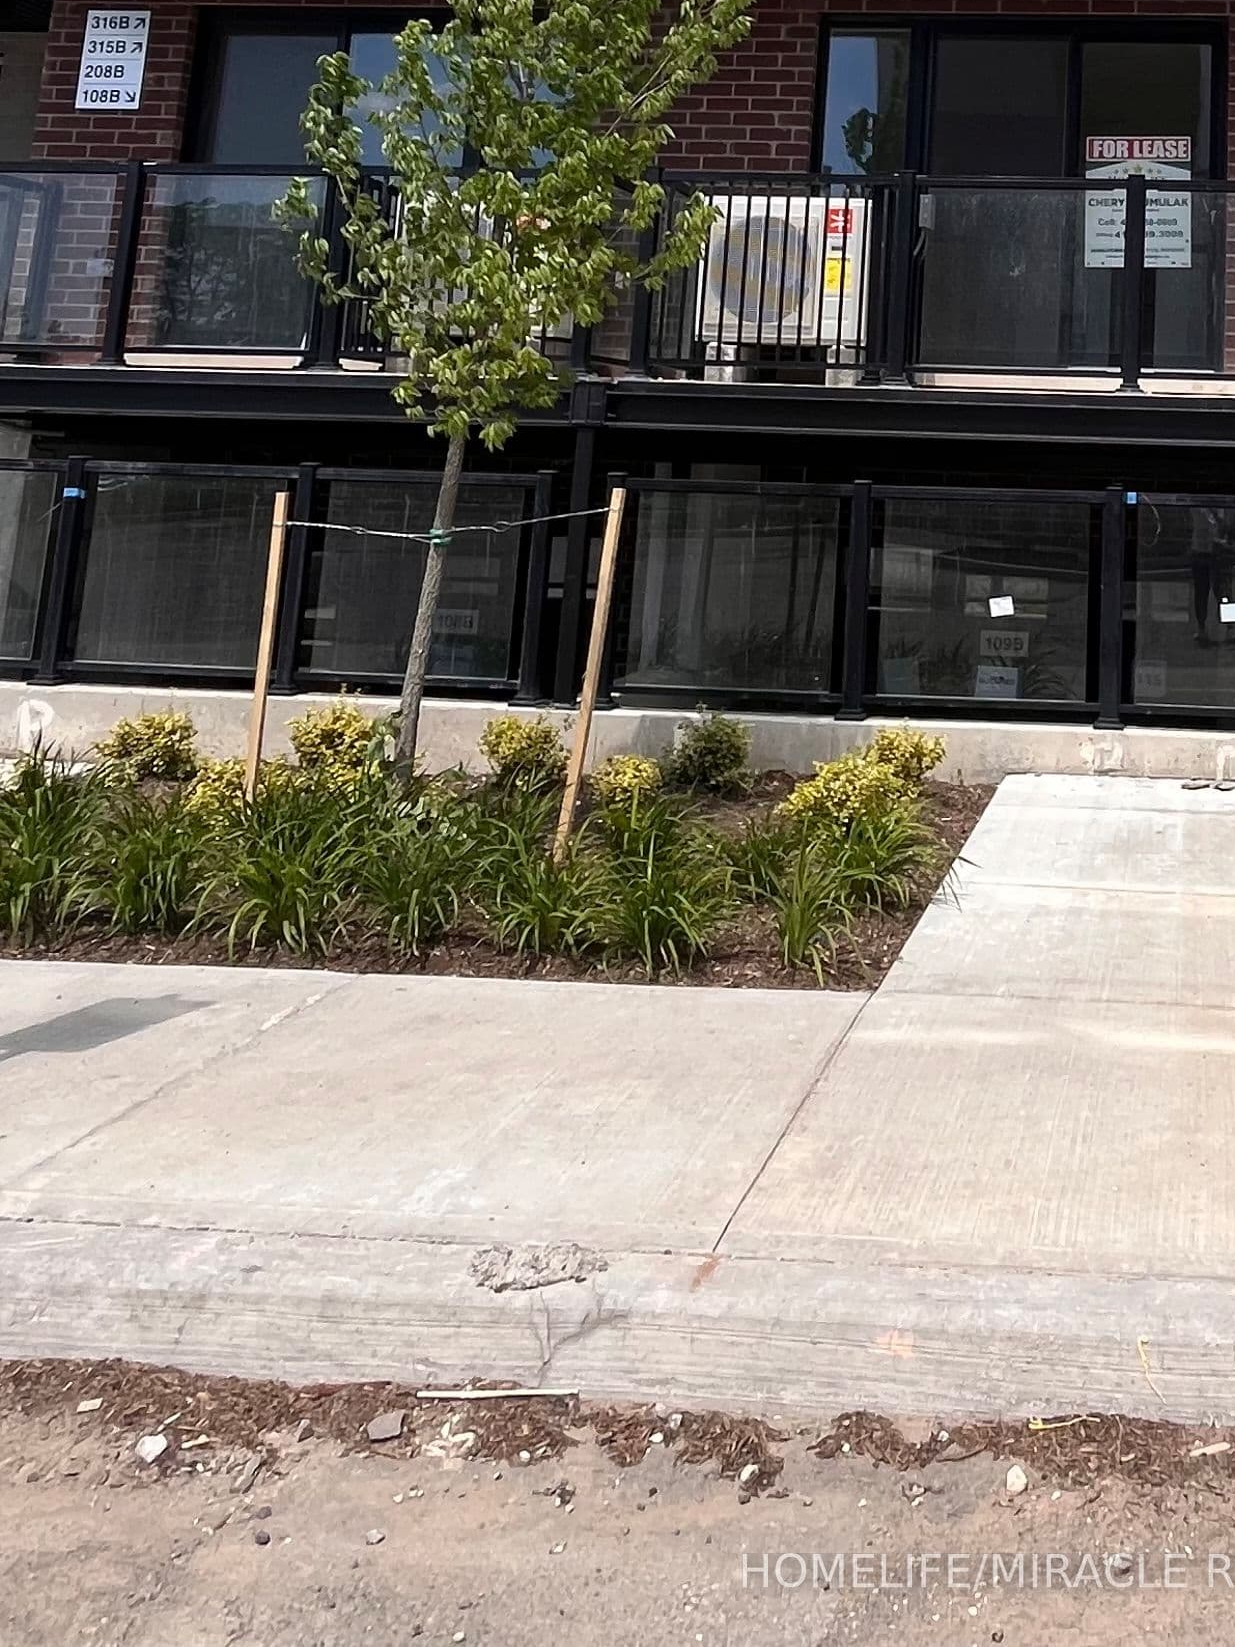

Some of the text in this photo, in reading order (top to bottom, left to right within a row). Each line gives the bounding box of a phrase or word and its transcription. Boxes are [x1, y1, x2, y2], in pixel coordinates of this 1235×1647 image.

[91, 16, 130, 29] 316B
[87, 40, 126, 53] 315B
[84, 64, 125, 78] 208B
[82, 89, 120, 103] 108B
[1092, 139, 1188, 159] FOR LEASE
[1088, 197, 1125, 207] CHERY
[985, 637, 1024, 651] 109B
